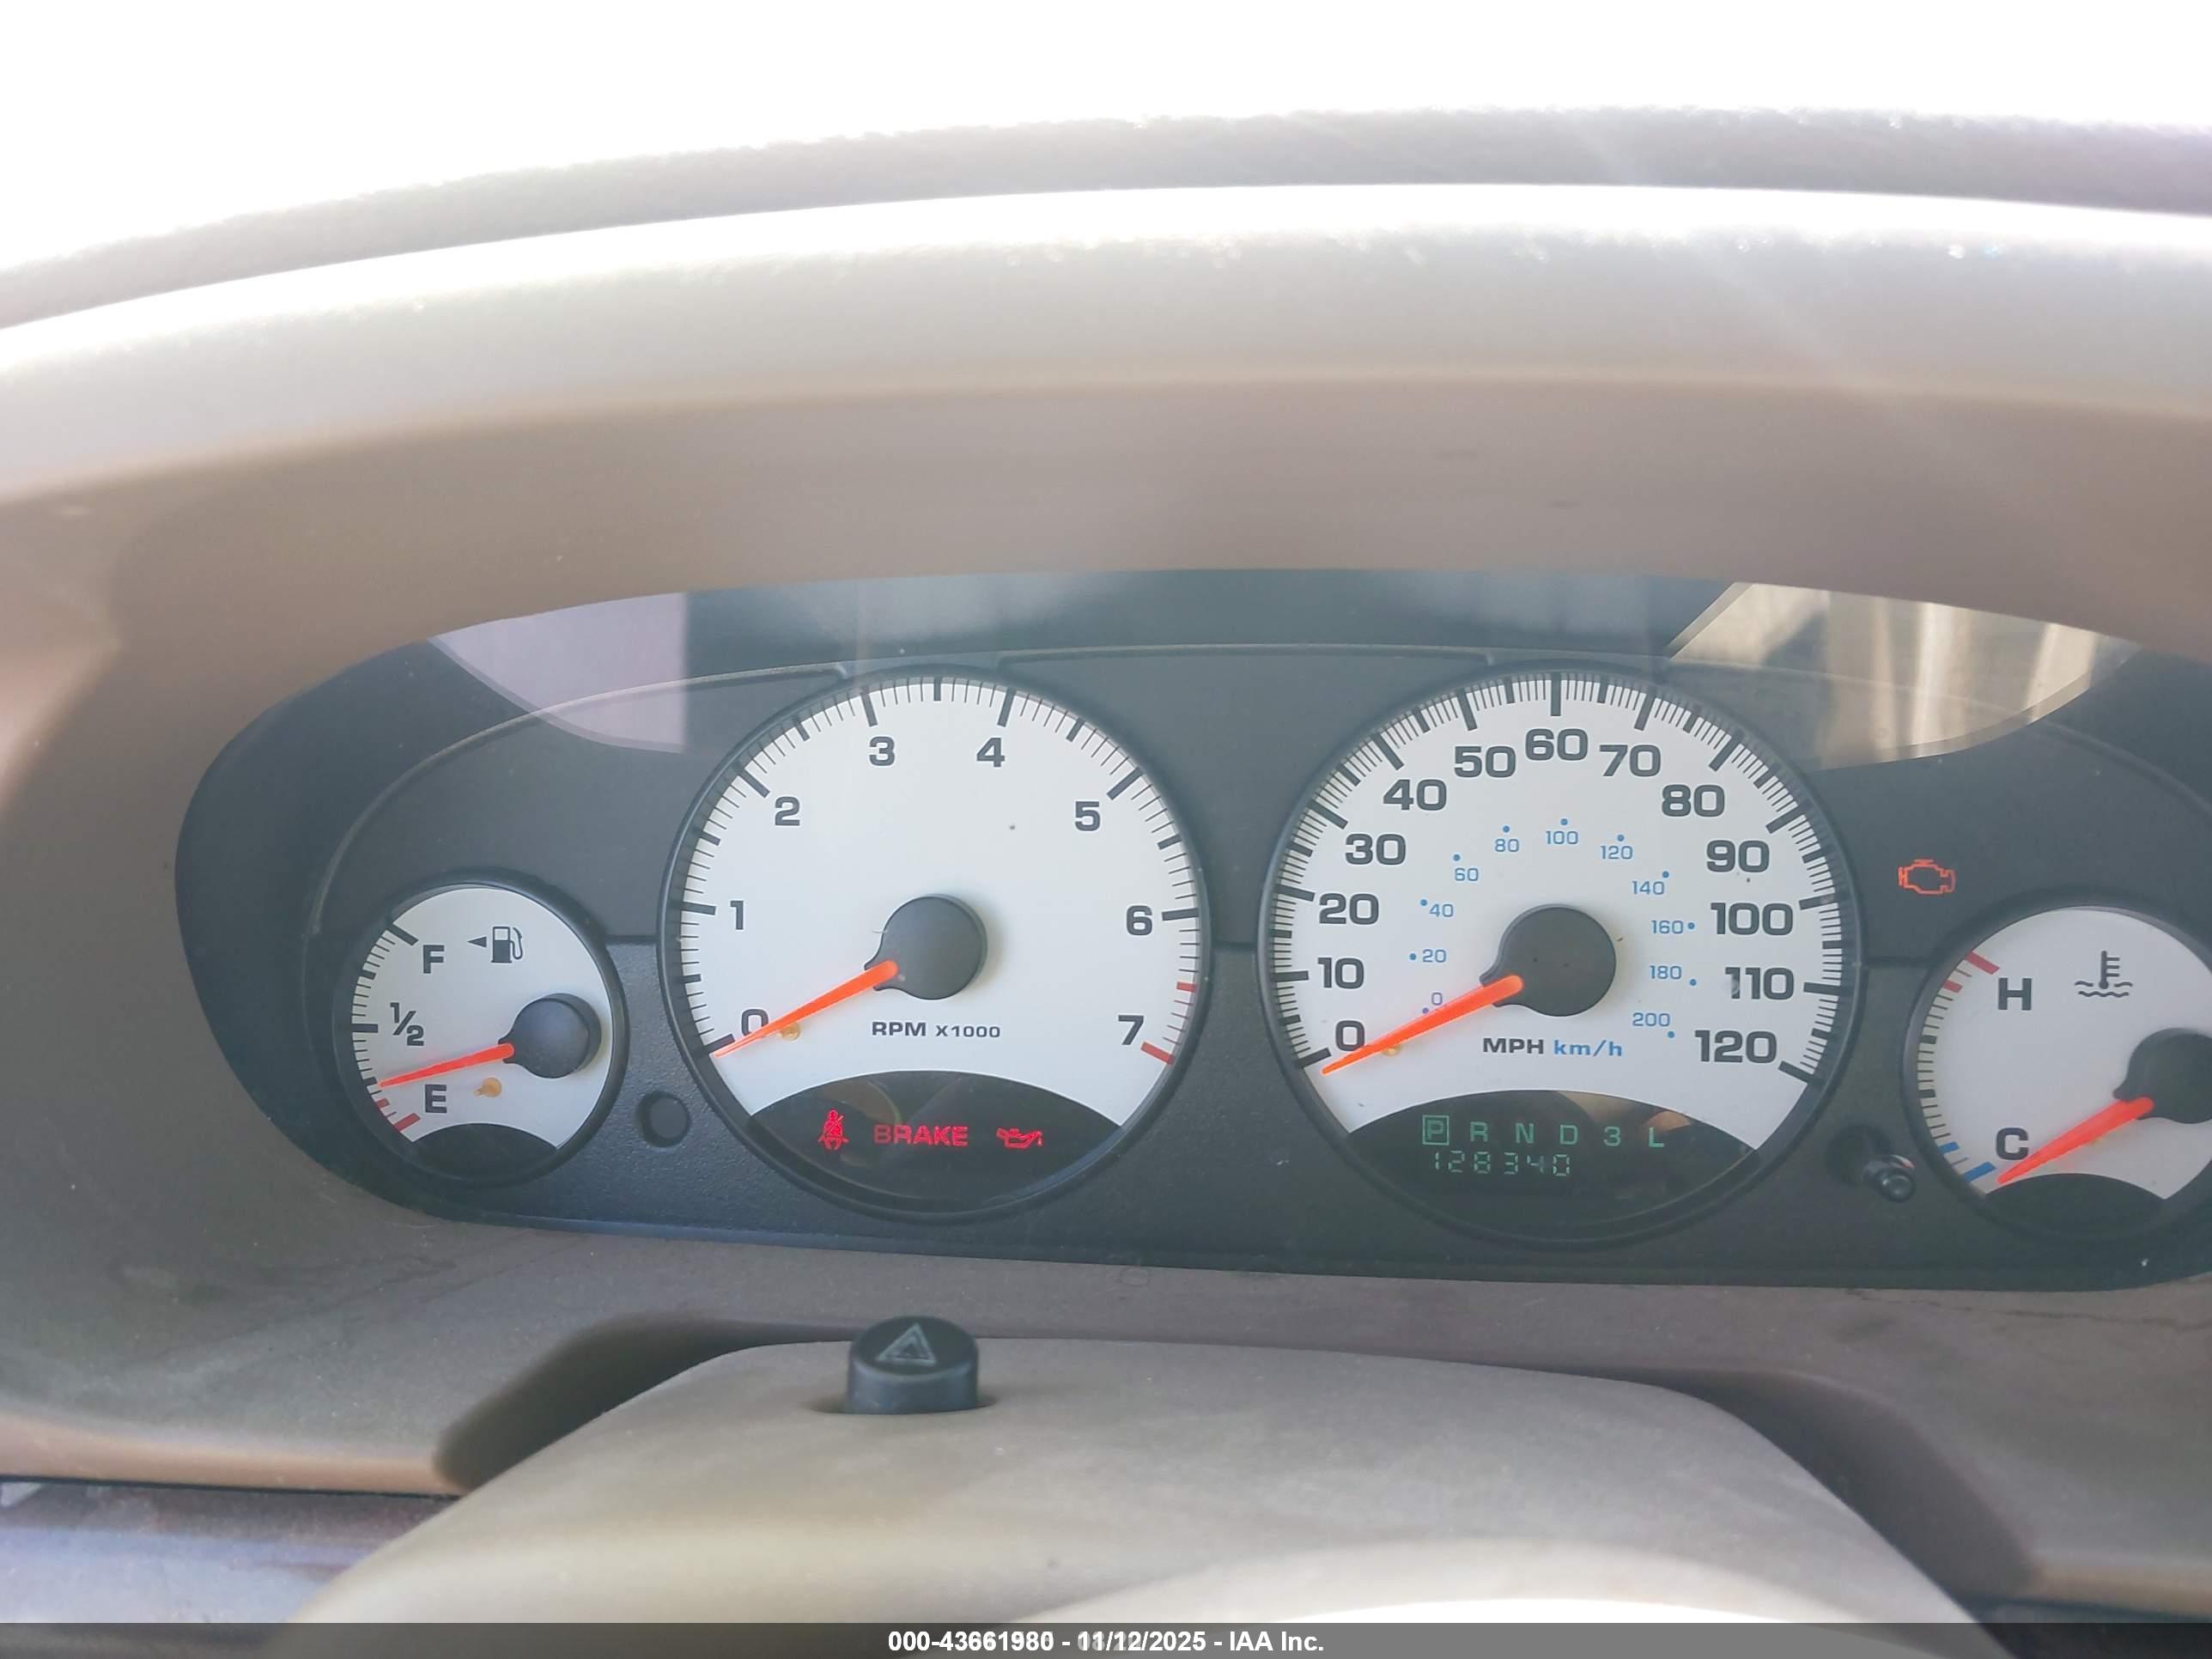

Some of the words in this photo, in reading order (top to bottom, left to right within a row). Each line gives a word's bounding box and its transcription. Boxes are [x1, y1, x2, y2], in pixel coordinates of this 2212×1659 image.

[869, 737, 895, 766] 3
[976, 738, 1006, 768] 4
[1525, 728, 1588, 760] 60
[1454, 746, 1516, 778] 50
[1600, 744, 1661, 776] 70
[1383, 780, 1447, 811] 40
[1661, 785, 1724, 817] 80
[774, 797, 800, 826] 2
[1074, 801, 1101, 830] 5
[1345, 834, 1406, 865] 30
[1495, 839, 1519, 853] 80
[1546, 830, 1578, 845] 100
[1600, 845, 1633, 860] 120
[1706, 841, 1770, 872] 90
[1454, 867, 1479, 882] 60
[1632, 880, 1664, 895] 140
[730, 901, 744, 930] 1
[1127, 905, 1152, 936] 6
[1318, 893, 1379, 925] 20
[1429, 902, 1453, 917] 40
[1710, 903, 1793, 935] 100
[1651, 921, 1683, 934] 160
[422, 945, 445, 974] F
[1422, 949, 1446, 963] 20
[1317, 957, 1364, 988] 10
[1650, 965, 1681, 980] 180
[1724, 968, 1793, 1000] 110
[1431, 992, 1442, 1006] 0
[1998, 978, 2032, 1011] H
[741, 1009, 769, 1037] 0
[872, 1022, 927, 1036] RPM
[1118, 1015, 1145, 1045] 7
[1632, 1012, 1670, 1027] 200
[1334, 1020, 1365, 1052] 0
[1483, 1037, 1543, 1054] MPH
[1553, 1040, 1622, 1057] km/h
[1694, 1030, 1777, 1063] 120
[424, 1084, 447, 1114] E
[874, 1125, 969, 1147] BRAKE
[1425, 1119, 1444, 1139] P
[1469, 1121, 1489, 1142] R
[1515, 1122, 1534, 1144] N
[1559, 1124, 1579, 1145] D
[1603, 1126, 1621, 1146] 3
[1648, 1127, 1665, 1147] L
[1996, 1127, 2028, 1160] C
[1434, 1150, 1571, 1176] 128340
